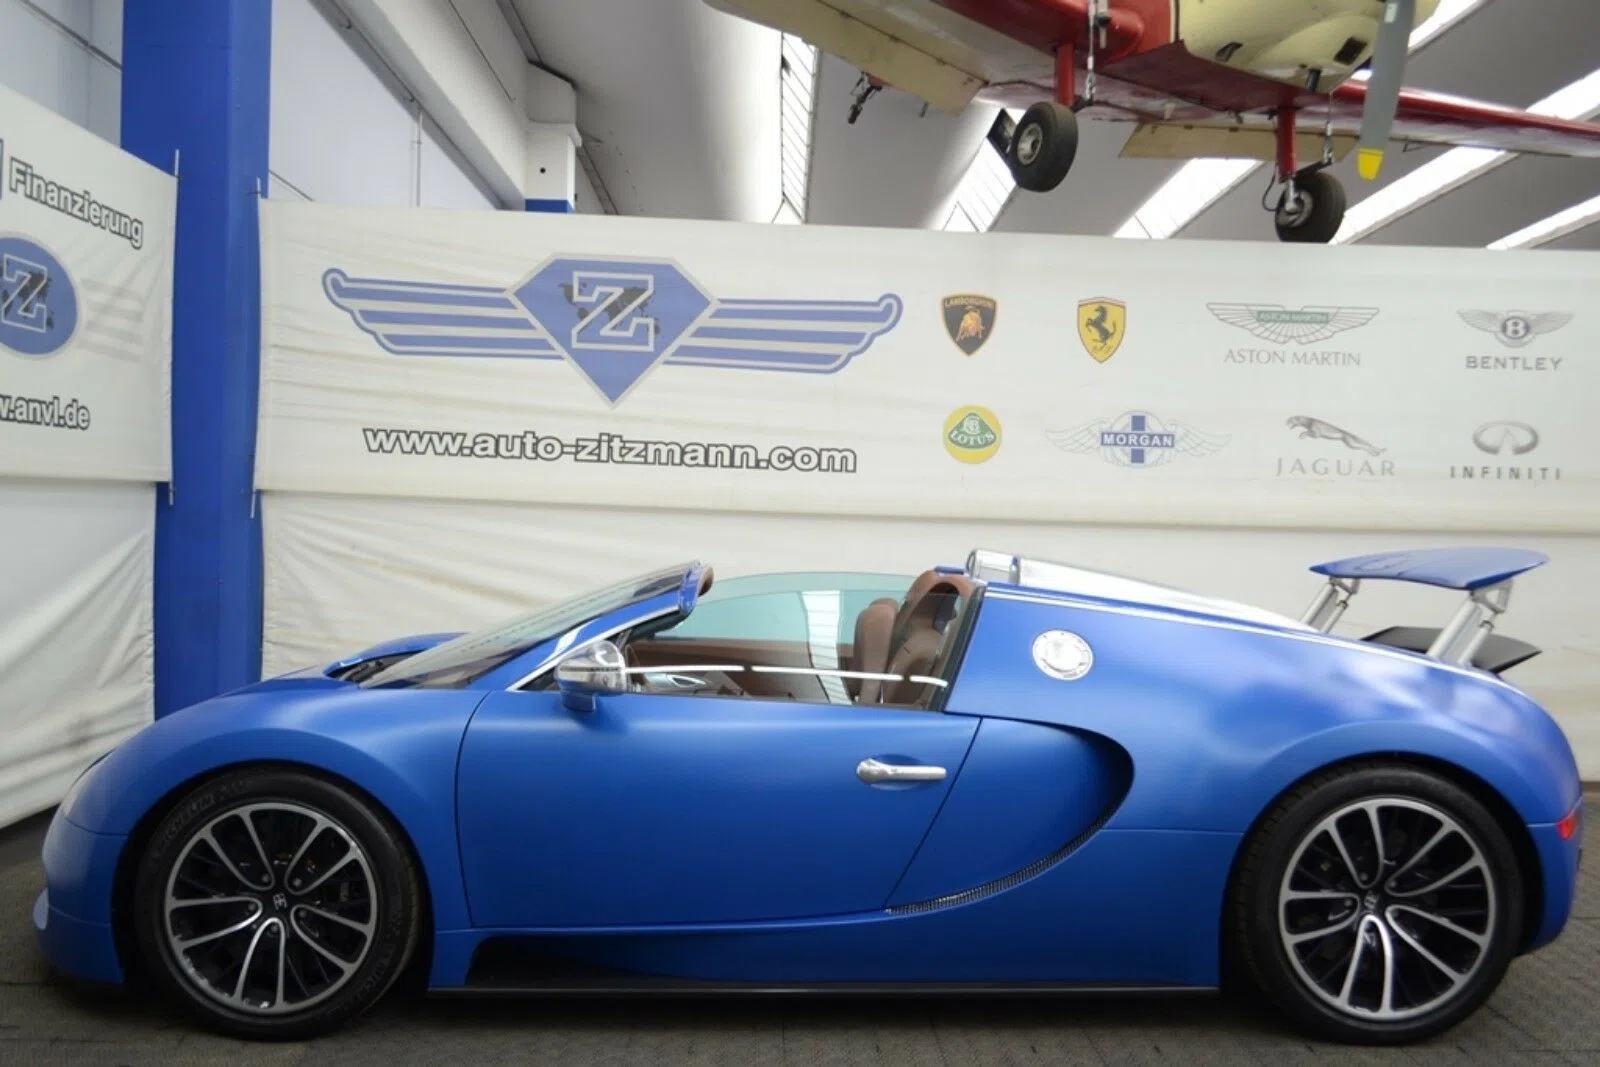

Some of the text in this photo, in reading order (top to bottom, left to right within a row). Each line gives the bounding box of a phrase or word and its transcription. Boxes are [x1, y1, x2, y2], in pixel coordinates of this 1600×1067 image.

[9, 156, 143, 249] Finanzierung
[571, 271, 655, 353] Z
[1223, 348, 1361, 368] ASTON MARTIN
[1465, 355, 1562, 371] BENTLEY
[950, 430, 995, 446] LOTUS
[1102, 433, 1174, 447] MORGAN
[363, 427, 857, 472] www.auto-zitzmann.com
[1276, 457, 1396, 477] JAGUAR
[1449, 466, 1562, 480] INFINITI
